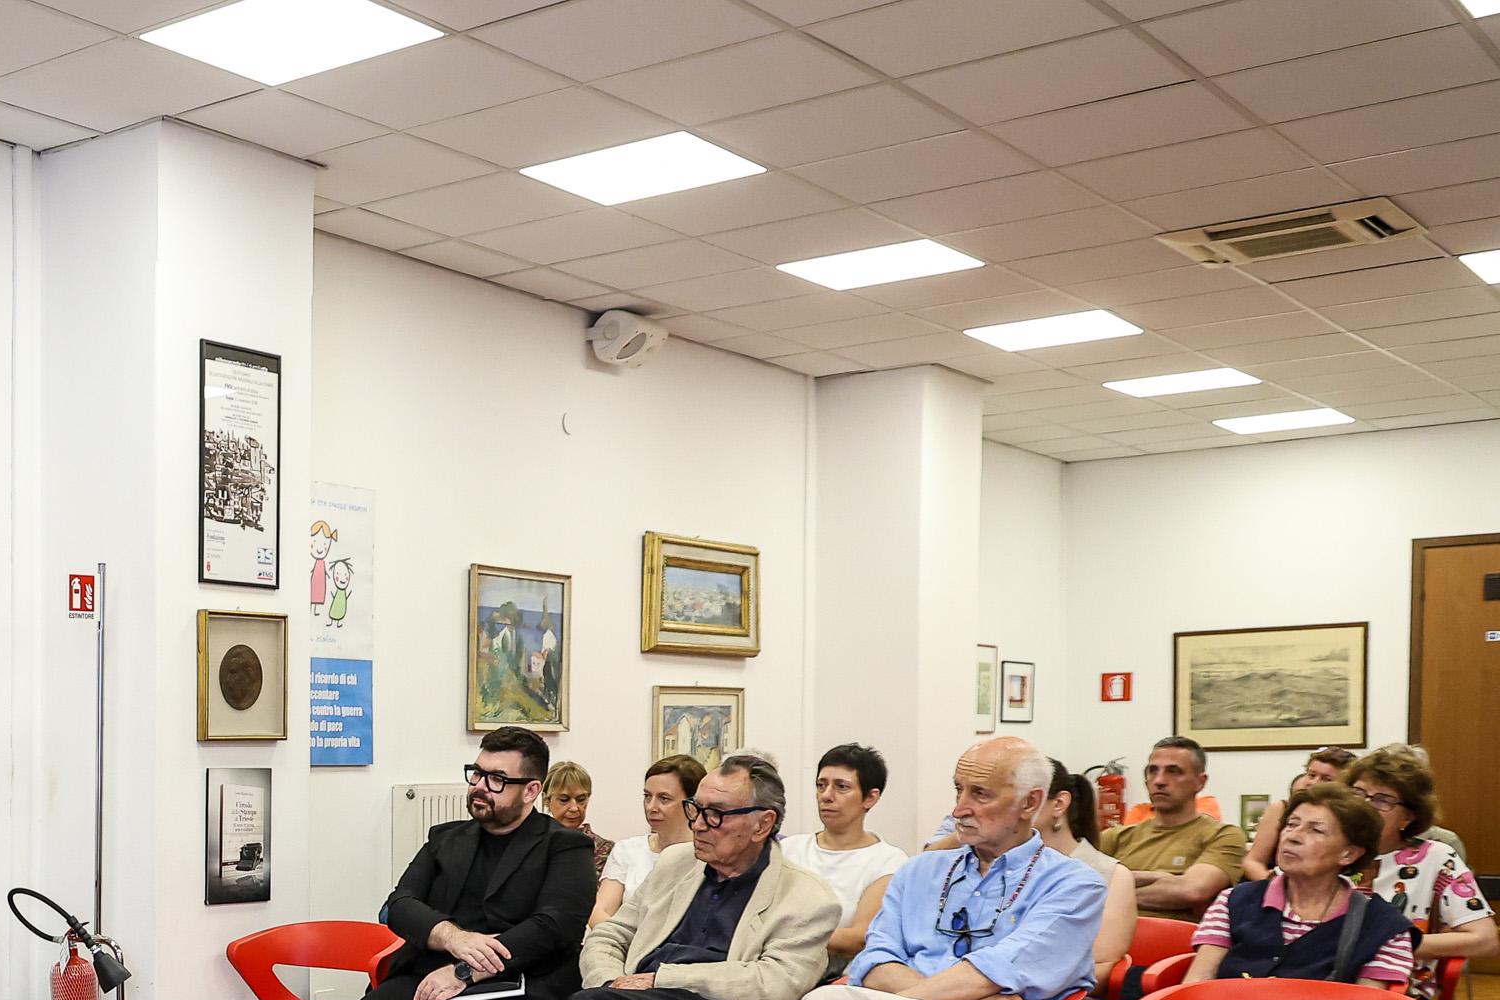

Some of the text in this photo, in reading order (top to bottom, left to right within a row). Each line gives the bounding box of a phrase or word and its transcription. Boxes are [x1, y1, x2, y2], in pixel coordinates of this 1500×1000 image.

[68, 612, 95, 620] ESTINTORE
[315, 672, 339, 685] ricordo
[339, 673, 347, 685] di
[347, 674, 357, 686] chi
[312, 704, 363, 718] contro la guerra
[319, 720, 327, 732] di
[327, 721, 343, 733] pace
[324, 736, 348, 749] propria
[348, 736, 361, 748] vita
